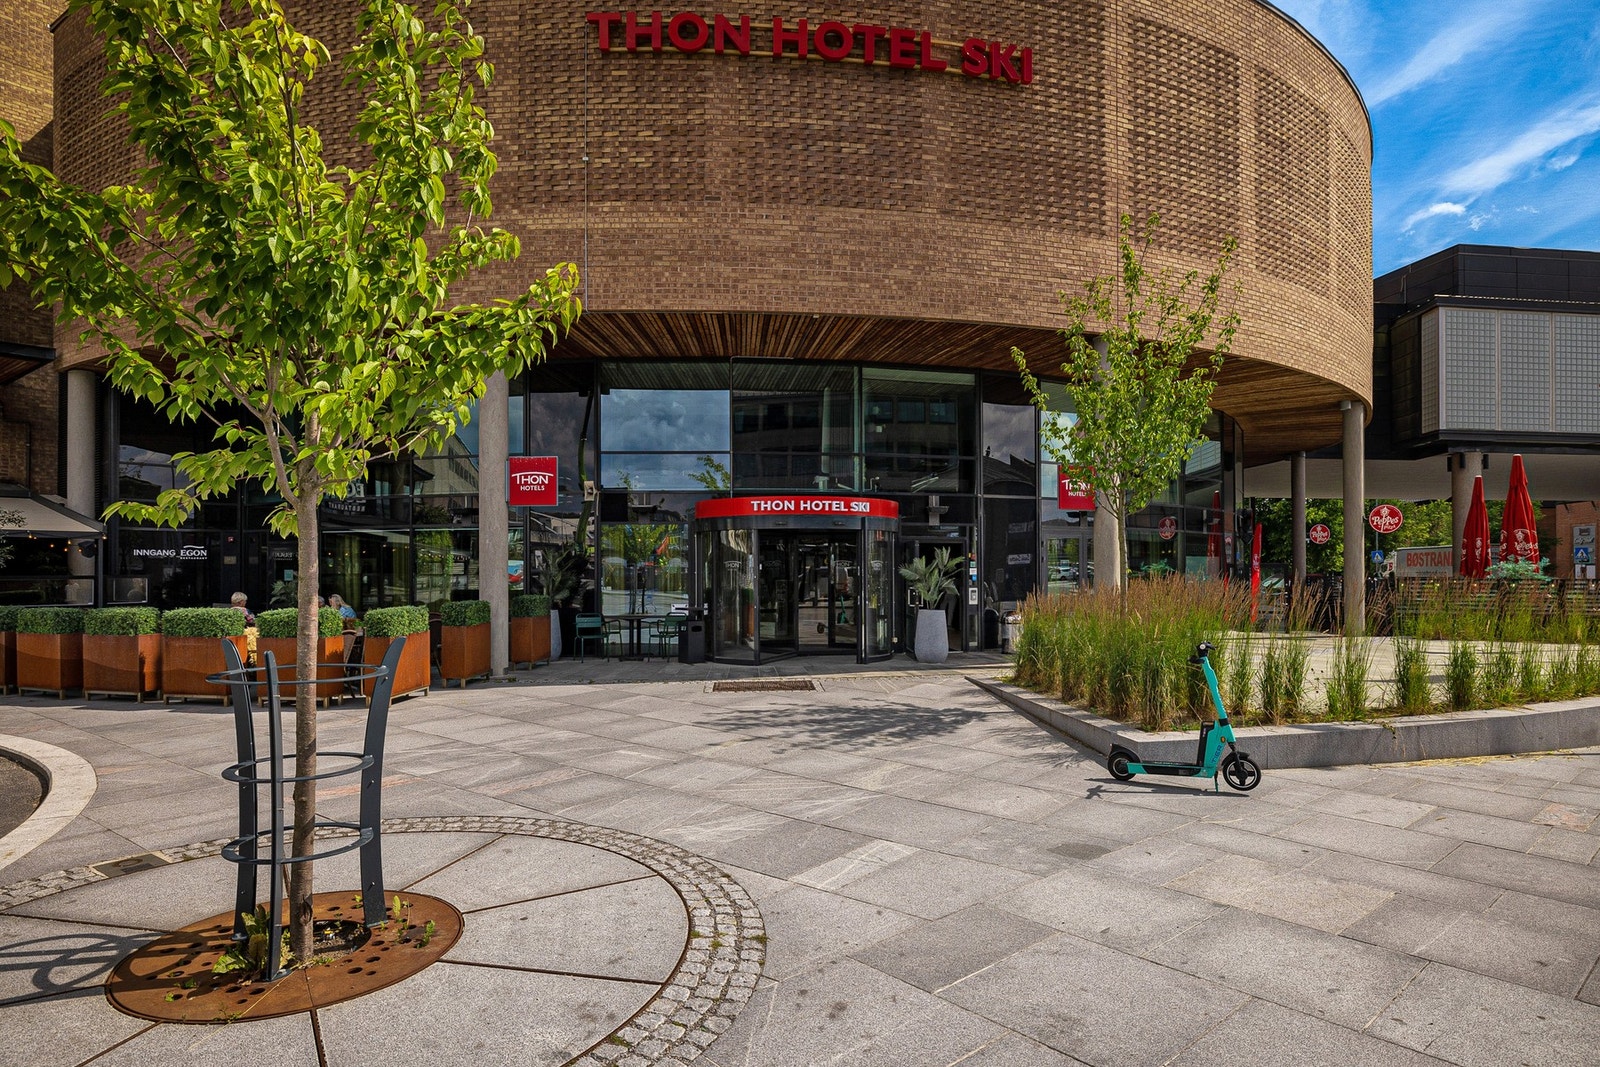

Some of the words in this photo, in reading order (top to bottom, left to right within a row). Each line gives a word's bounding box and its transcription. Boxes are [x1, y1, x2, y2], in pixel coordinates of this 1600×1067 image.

[587, 12, 750, 56] THON
[772, 17, 947, 71] HOTEL
[962, 38, 1033, 85] SKI
[512, 472, 554, 485] THON
[751, 500, 795, 511] THON
[800, 500, 848, 512] HOTEL
[850, 501, 870, 512] SKI
[180, 549, 207, 557] EGON
[1406, 551, 1453, 567] BØSTRAN
[1211, 744, 1223, 764] TIER
